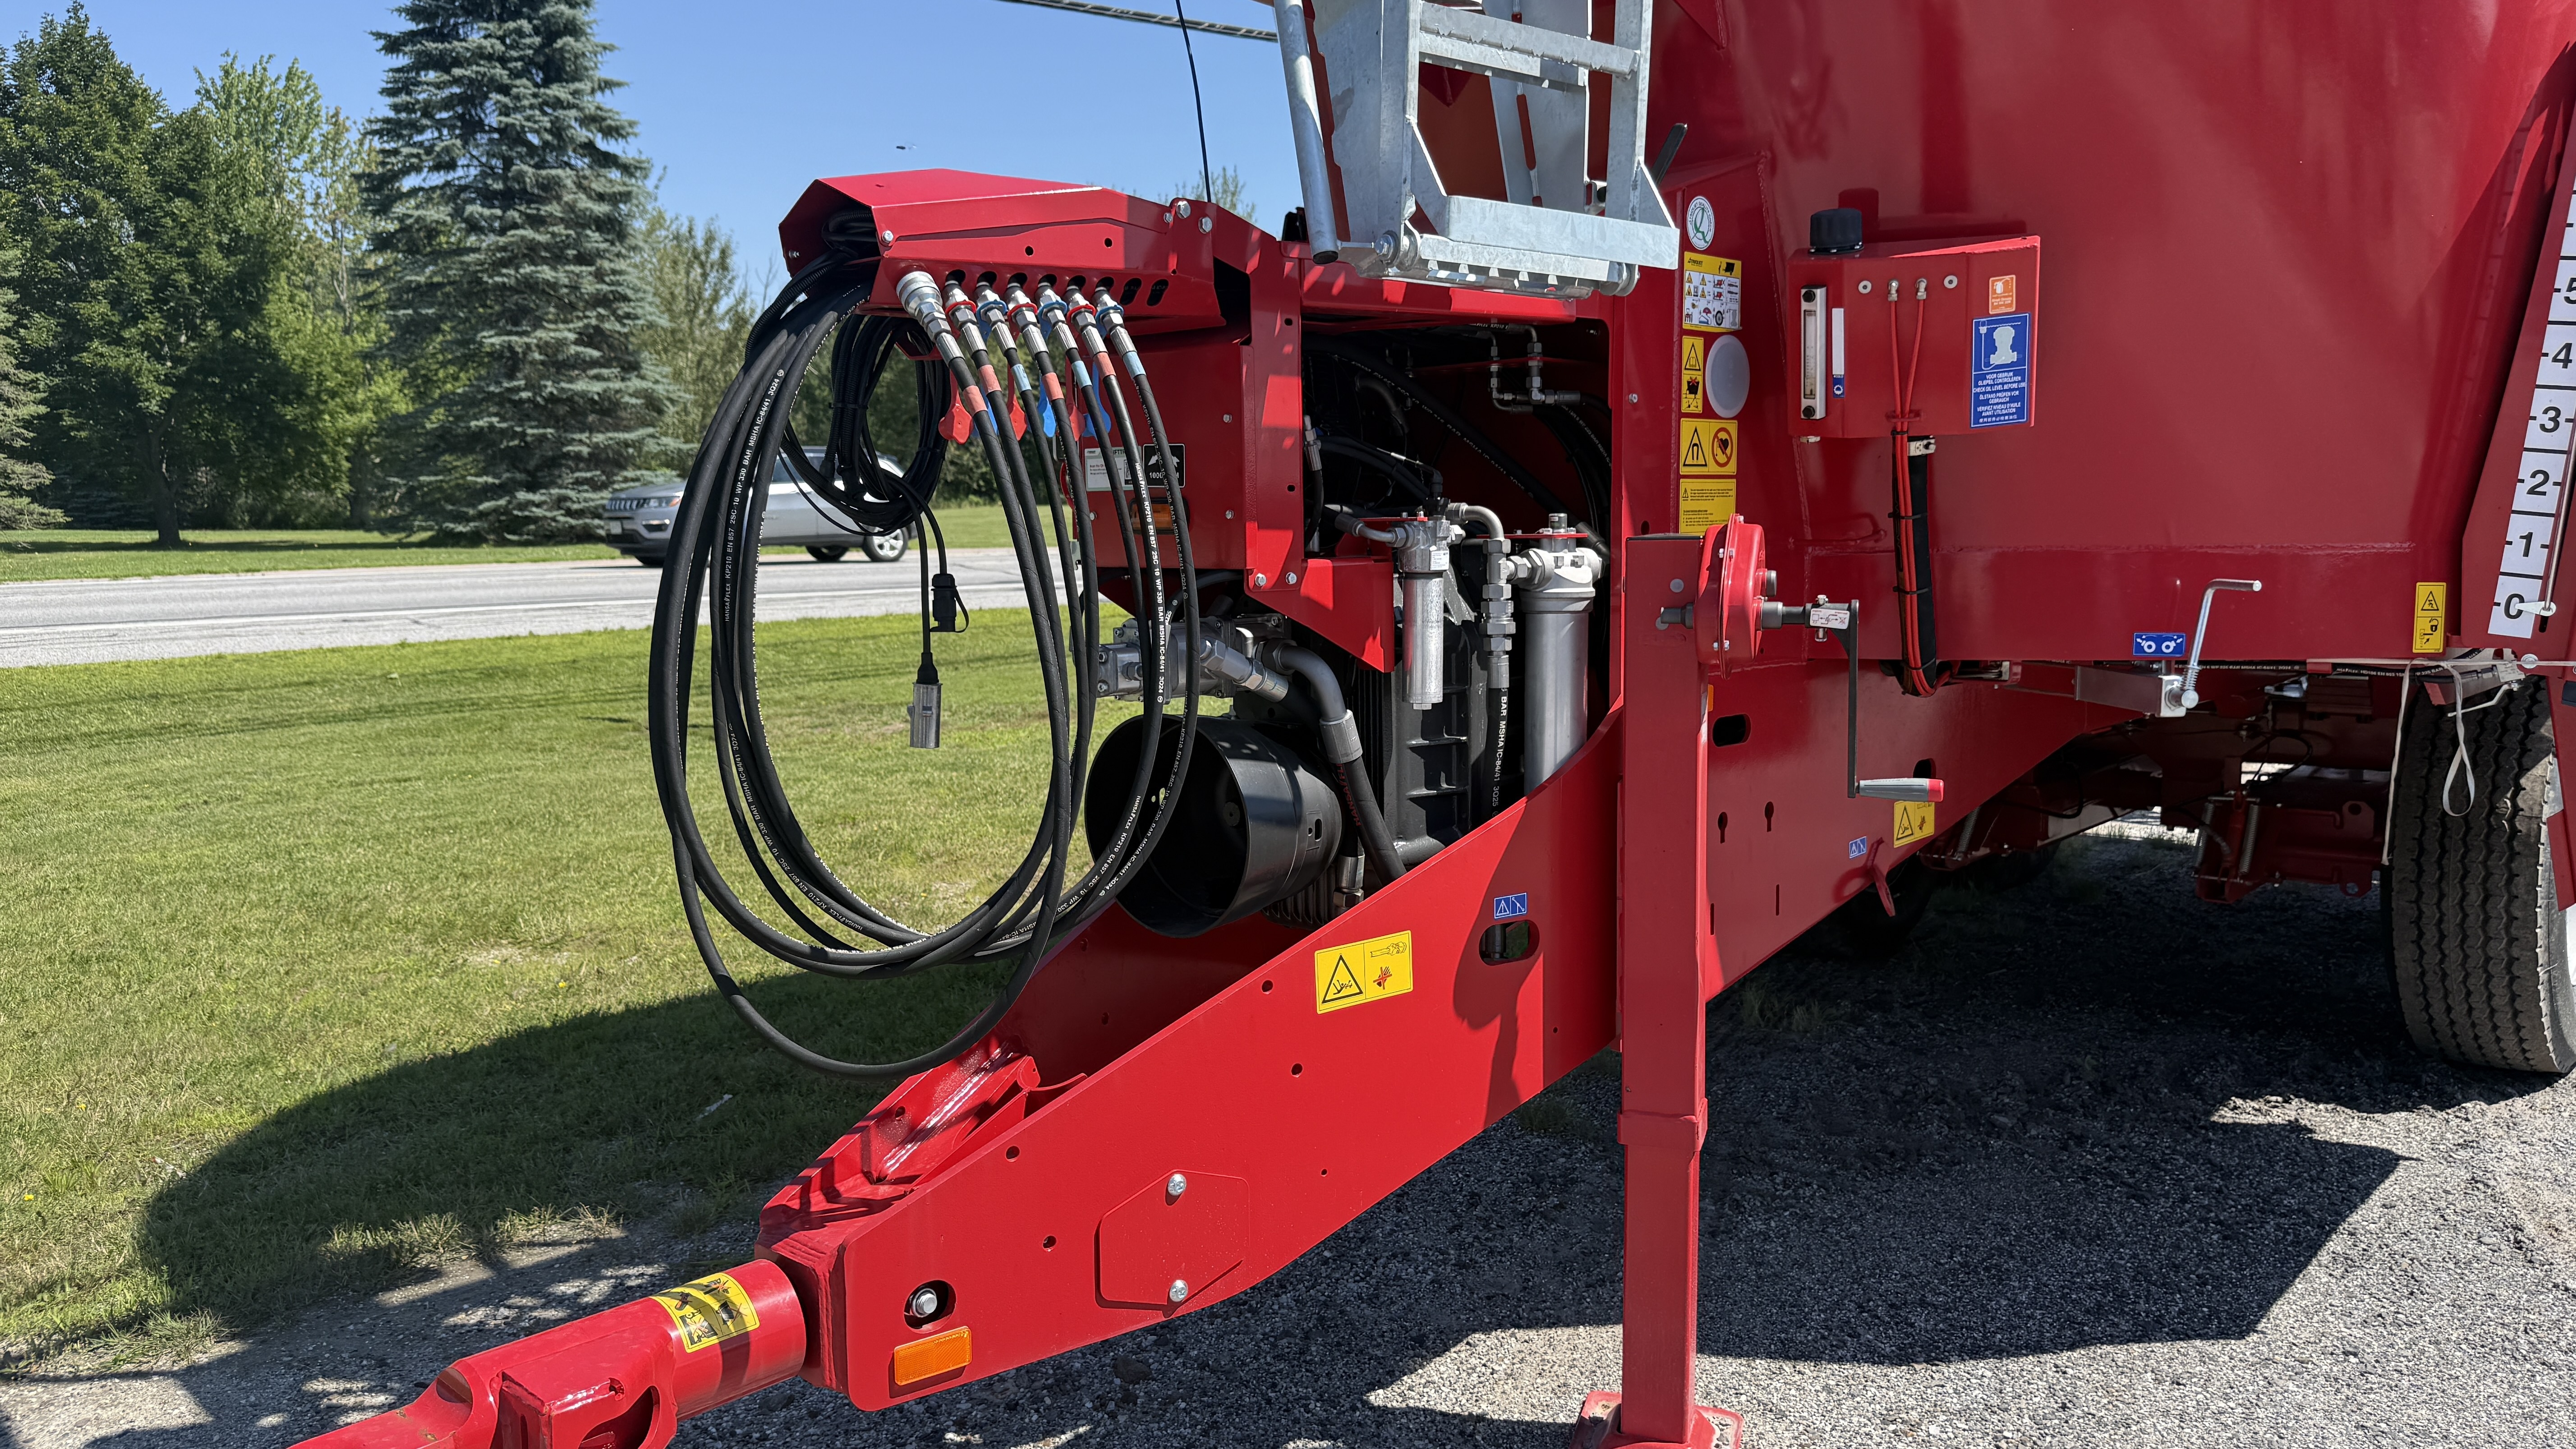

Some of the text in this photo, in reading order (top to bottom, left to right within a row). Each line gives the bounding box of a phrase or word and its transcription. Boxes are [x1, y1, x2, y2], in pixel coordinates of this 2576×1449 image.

[2551, 342, 2572, 369] 4
[2539, 406, 2561, 433] 3
[2526, 469, 2549, 496] 2
[1144, 501, 1152, 522] KP210
[1155, 579, 1162, 590] WP
[2520, 531, 2534, 558] 1
[2504, 593, 2525, 620] 0
[1498, 721, 1506, 747] MSHA
[1494, 749, 1504, 781] IC-84/41
[742, 781, 754, 803] MSHA
[750, 805, 760, 820] BAR
[758, 822, 768, 834] 330
[764, 835, 774, 846] WP
[1114, 832, 1127, 852] KP210
[772, 848, 780, 856] 10
[1107, 853, 1116, 864] EN
[778, 858, 790, 871] 2SC
[789, 873, 800, 884] 857
[1088, 875, 1100, 888] 2SC
[797, 882, 808, 892] EN
[808, 892, 828, 910] KP210
[1057, 902, 1068, 913] 330
[1069, 895, 1080, 905] WP
